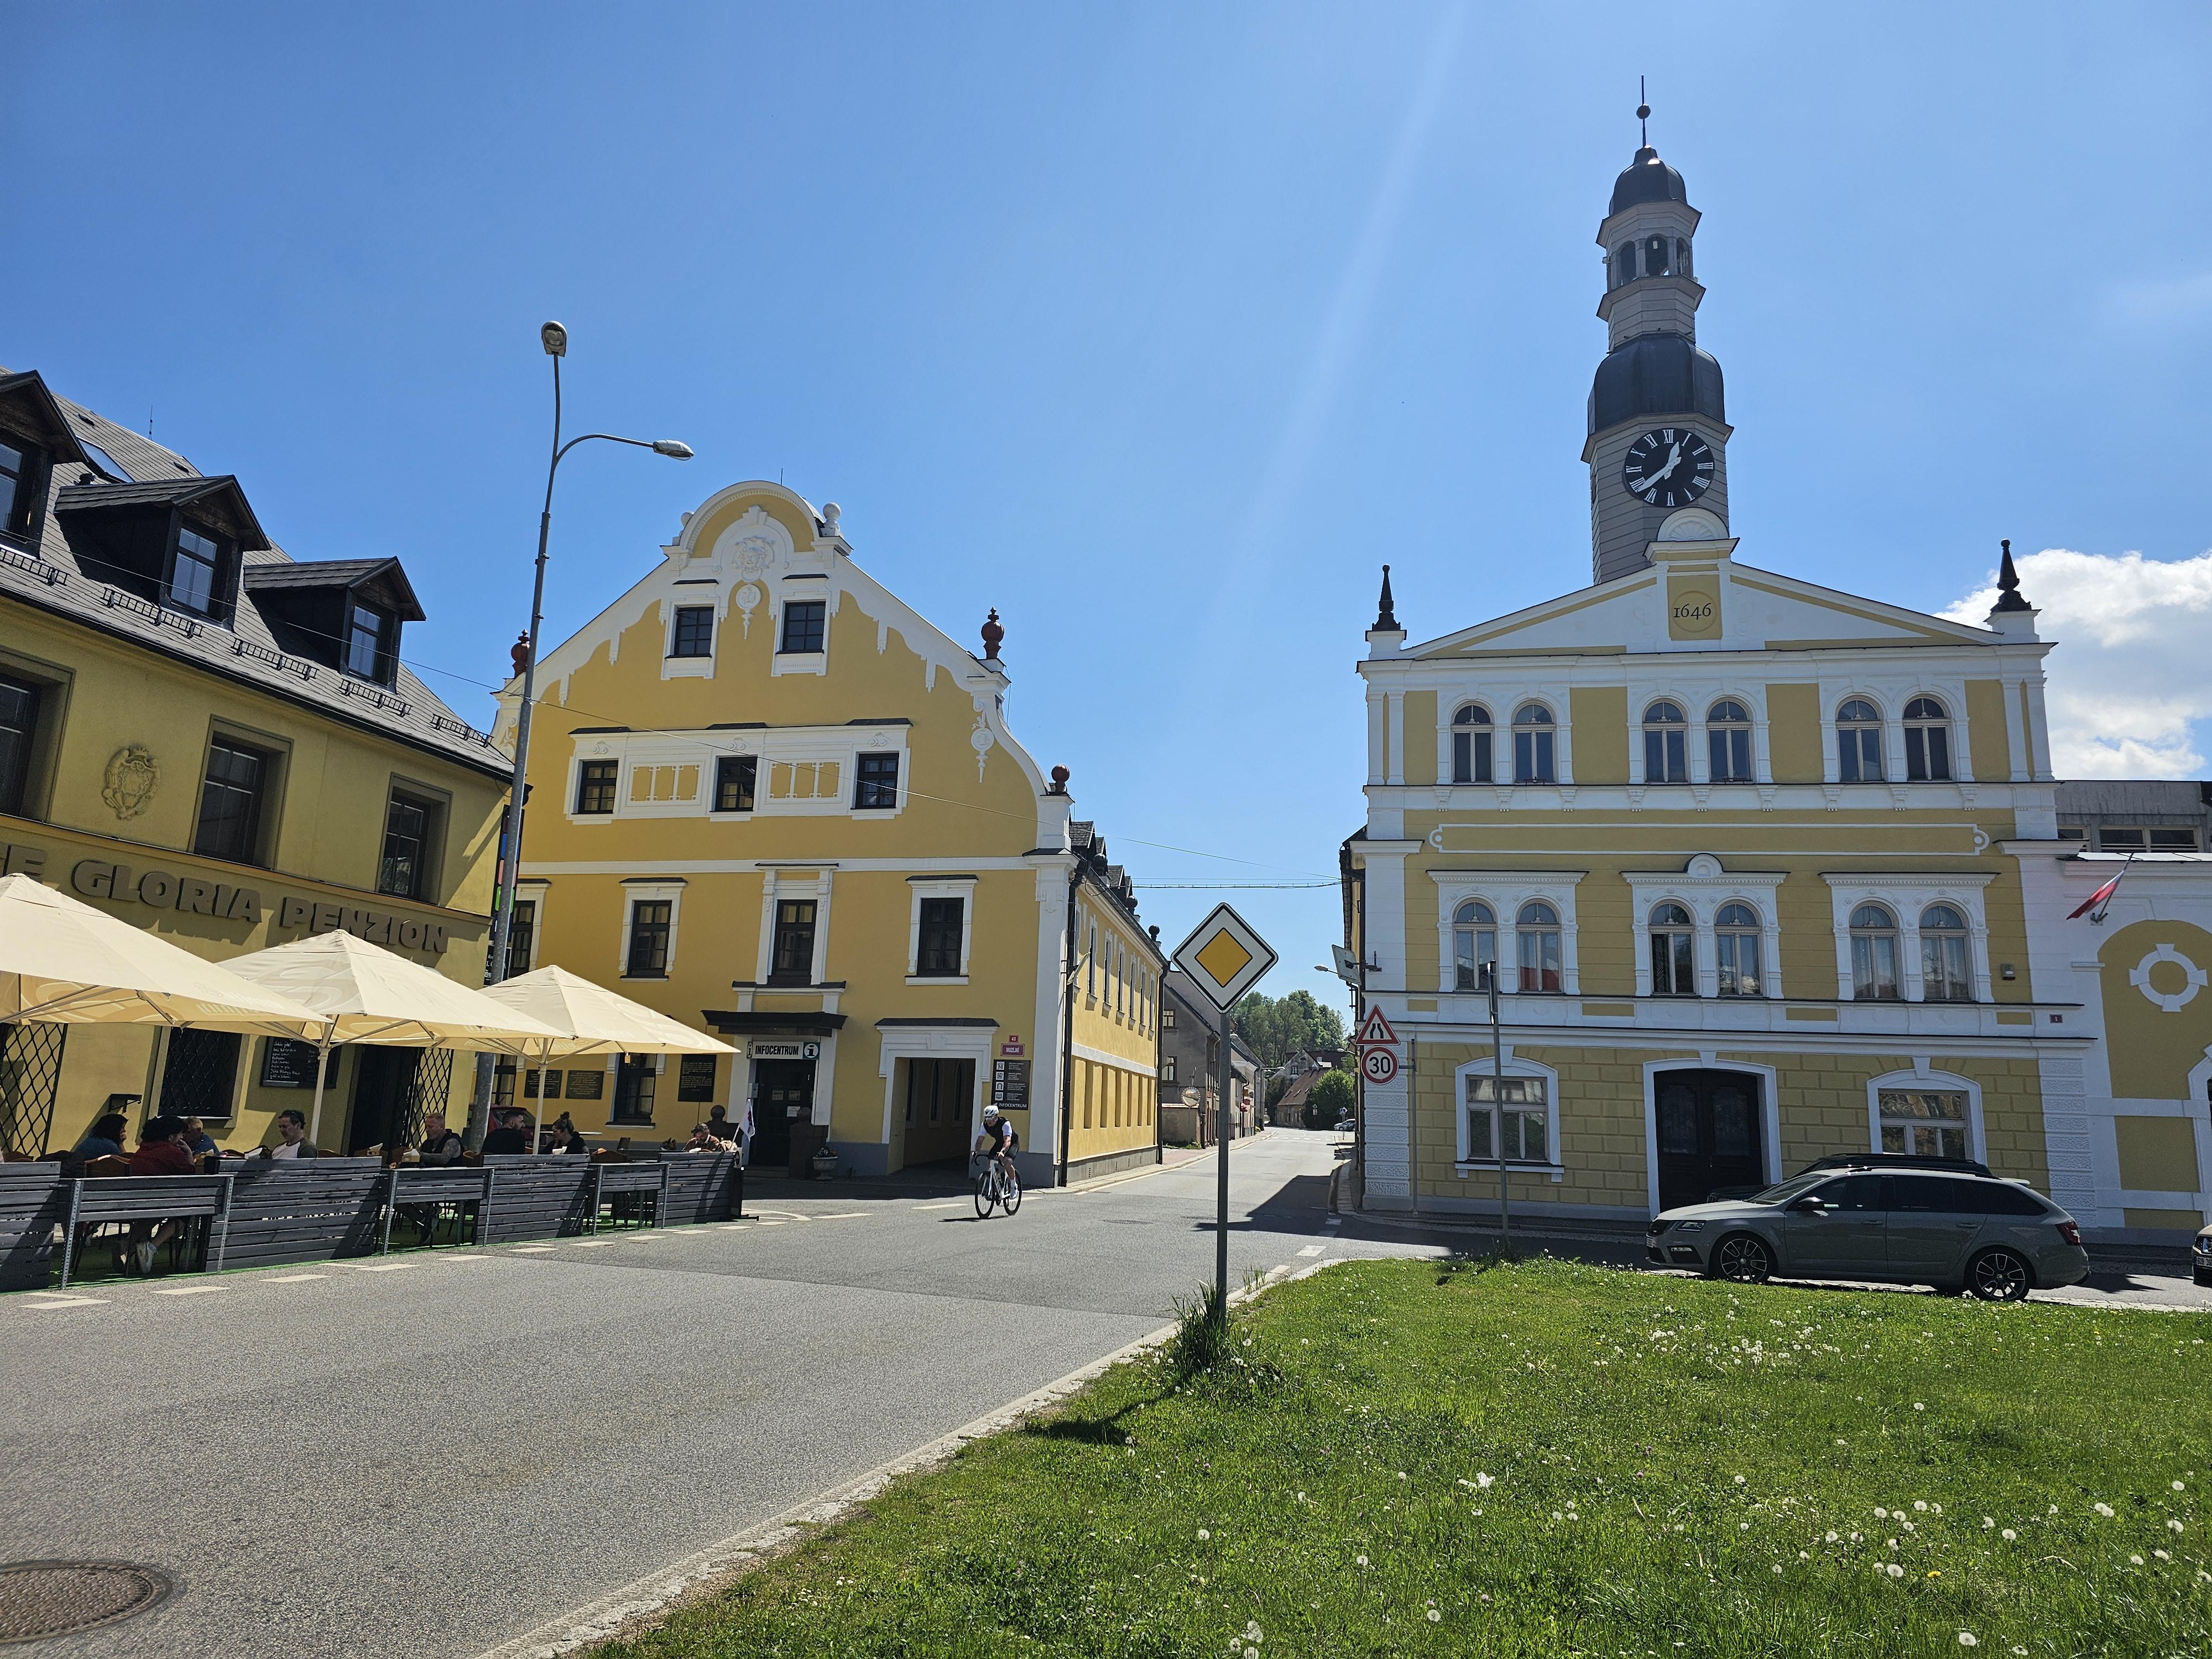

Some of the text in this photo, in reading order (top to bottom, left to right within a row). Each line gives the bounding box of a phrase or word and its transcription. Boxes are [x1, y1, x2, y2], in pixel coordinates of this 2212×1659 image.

[1643, 433, 1658, 449] XI
[1662, 429, 1674, 444] XII
[1681, 432, 1692, 446] I
[1630, 447, 1647, 458] X
[1692, 444, 1708, 456] II
[1697, 462, 1714, 470] III
[1673, 602, 1712, 620] 1646
[71, 858, 263, 922] GLORIA
[279, 896, 450, 953] PENZION
[755, 1045, 799, 1056] INFOCENTRUM
[1369, 1056, 1391, 1074] 30
